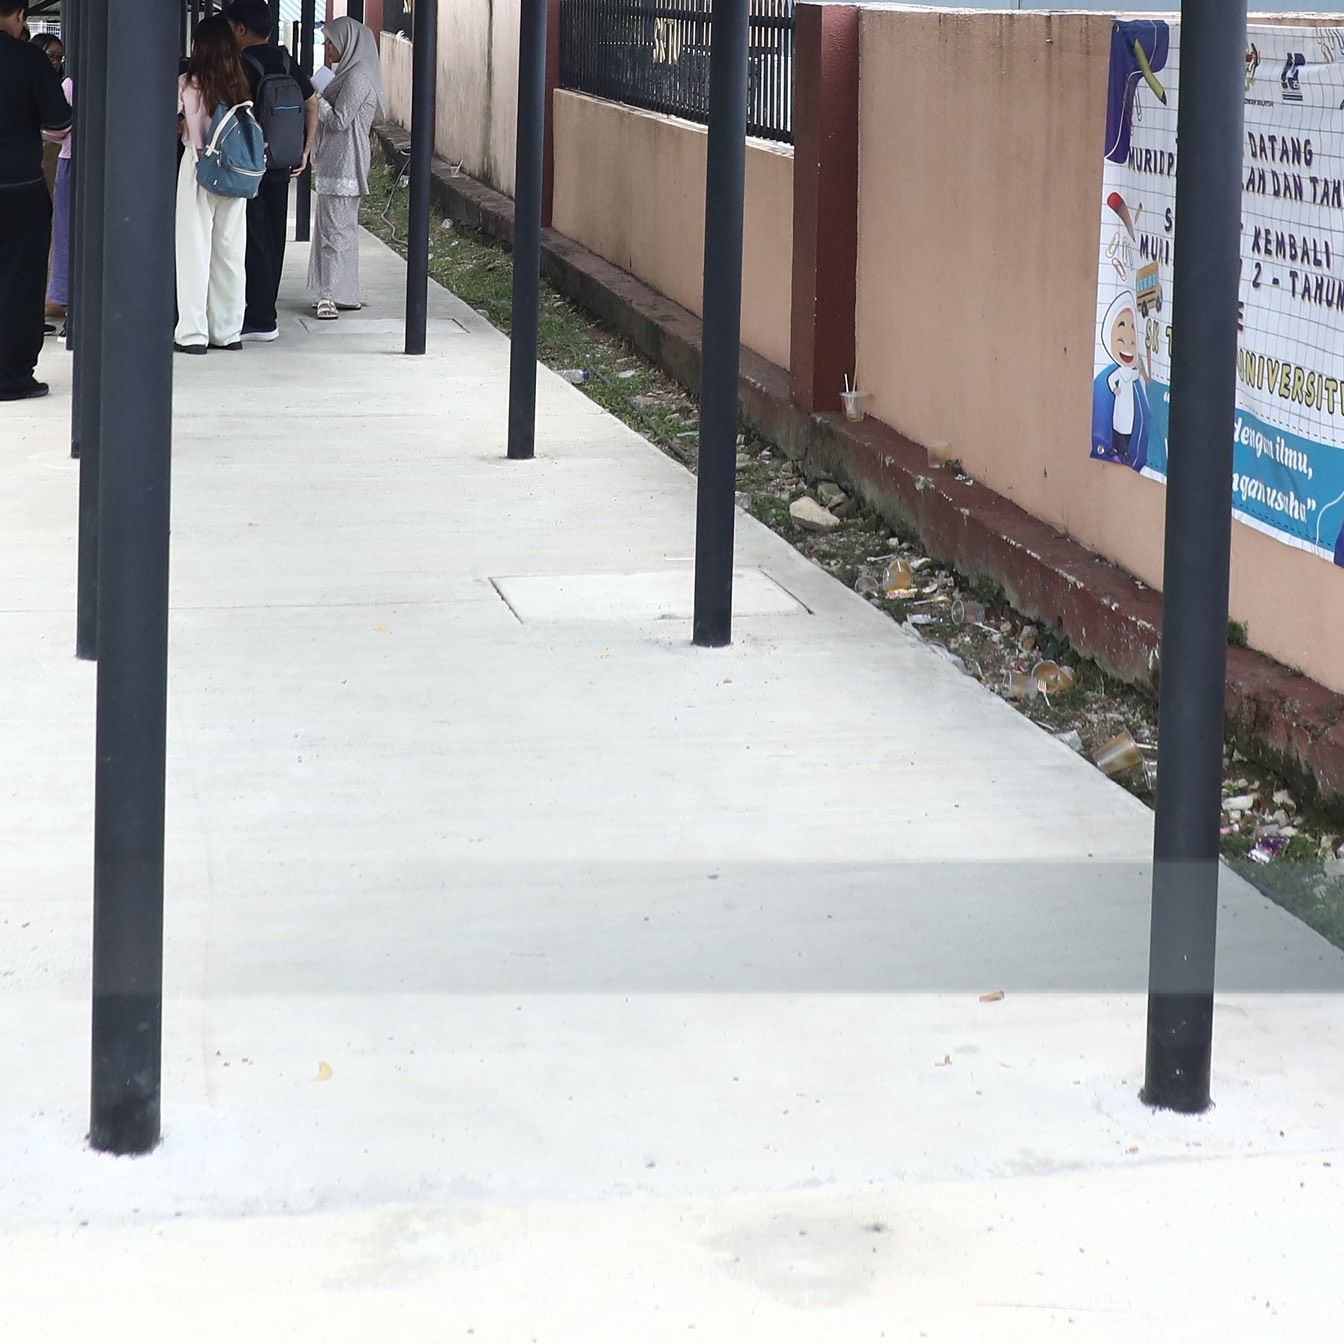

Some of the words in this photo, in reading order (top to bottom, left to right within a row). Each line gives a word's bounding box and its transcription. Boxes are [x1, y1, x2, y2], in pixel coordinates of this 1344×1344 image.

[1247, 131, 1314, 168] DATANG
[1272, 169, 1304, 202] DAN
[1251, 224, 1332, 268] KEMBALI
[1252, 261, 1262, 289] 2
[1275, 434, 1313, 480] ilmu,
